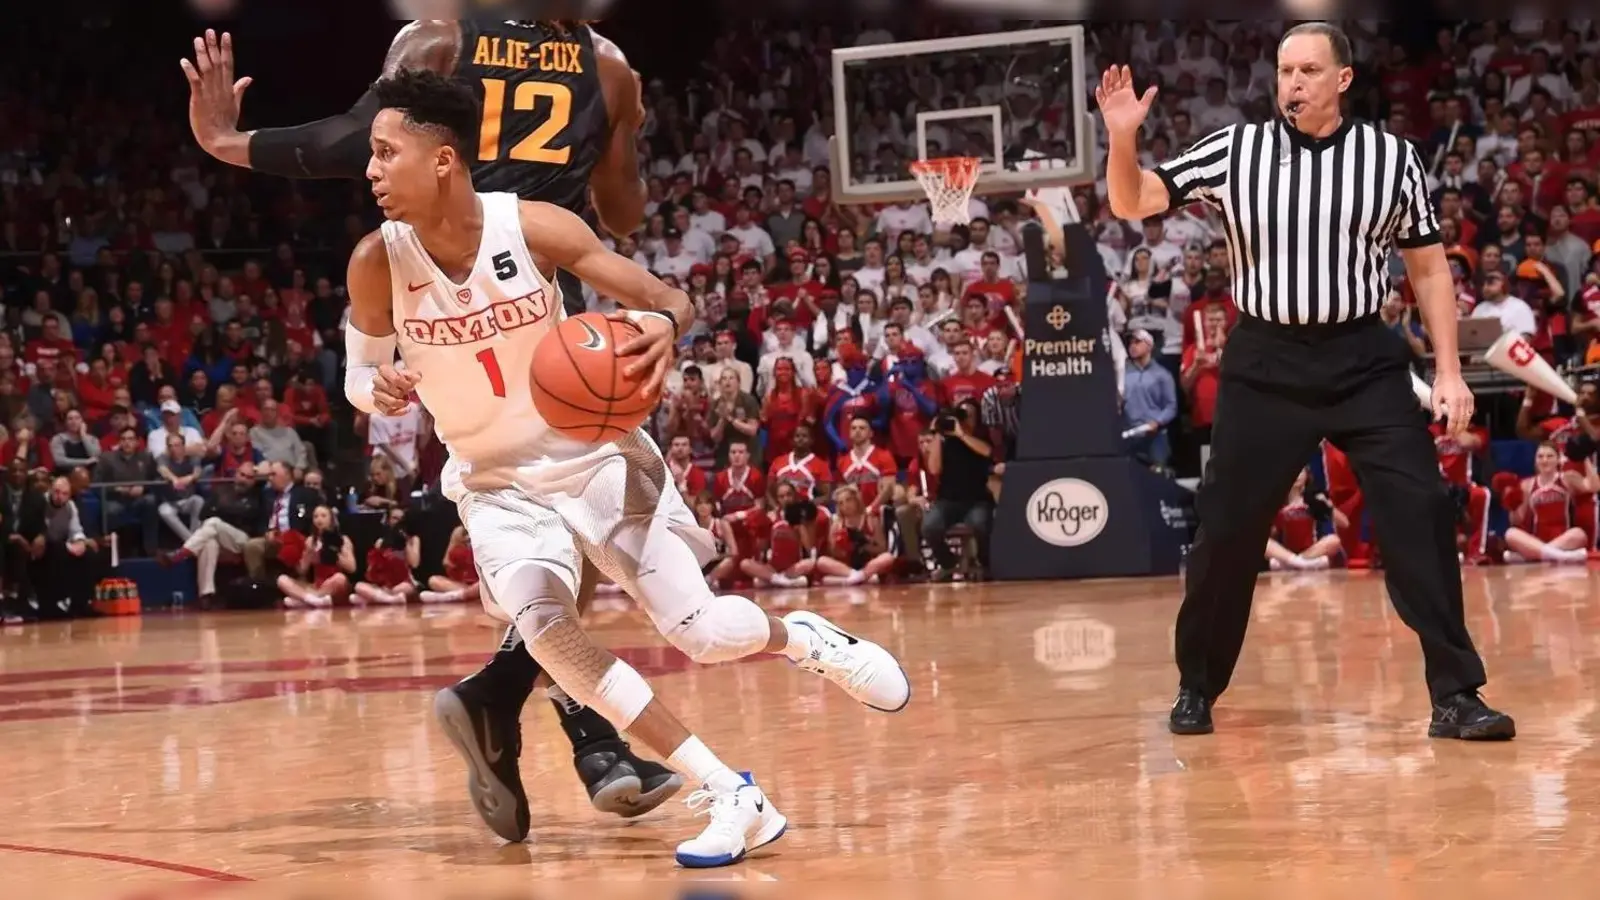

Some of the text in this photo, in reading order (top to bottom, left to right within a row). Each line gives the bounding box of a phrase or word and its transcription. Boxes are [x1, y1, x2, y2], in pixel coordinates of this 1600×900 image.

[472, 35, 583, 74] ALIE-COX
[478, 78, 572, 164] 12
[492, 250, 518, 281] 5
[404, 288, 548, 346] DAYTON
[1025, 335, 1096, 356] Premier
[1031, 355, 1092, 377] Health
[476, 348, 506, 398] 1
[1037, 491, 1100, 537] Kroger
